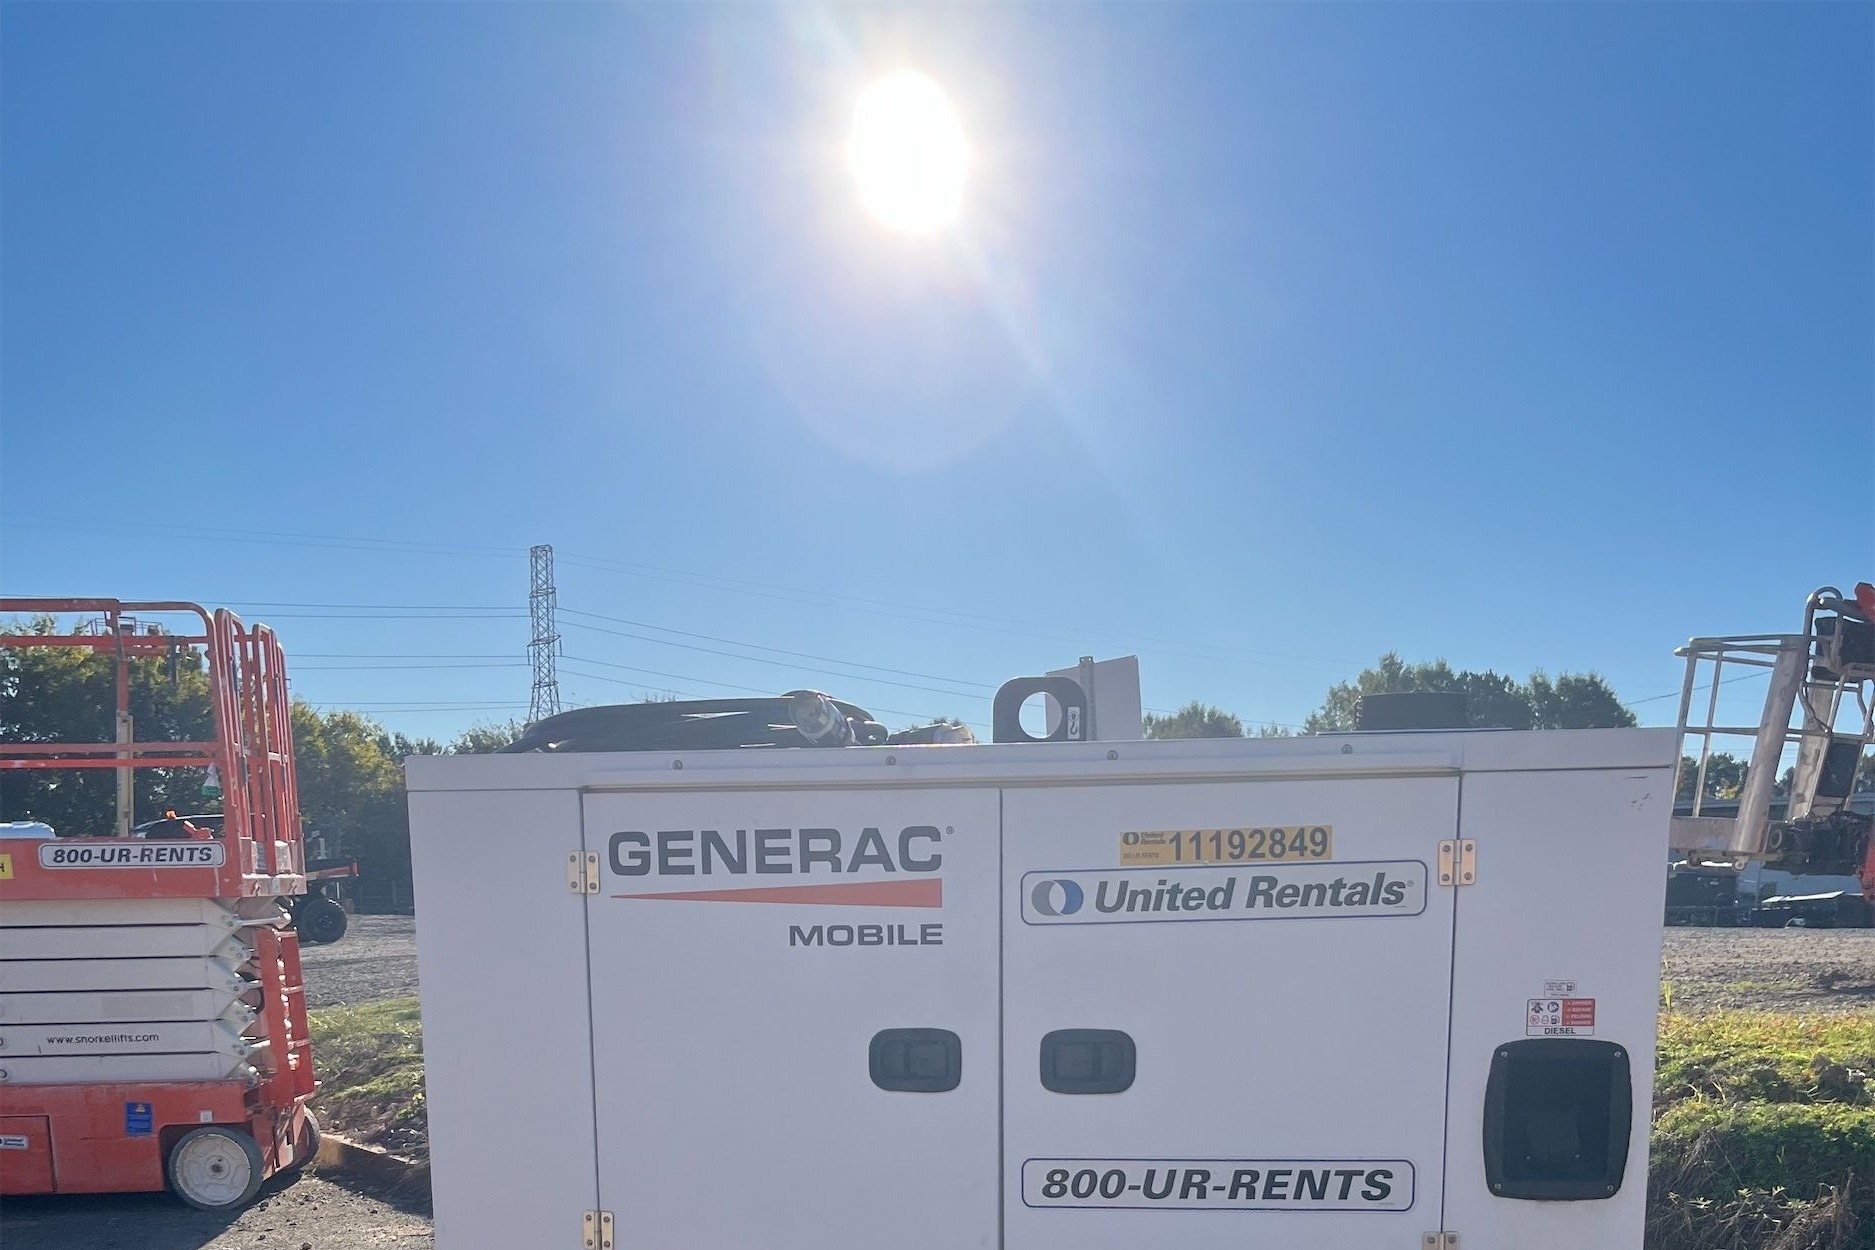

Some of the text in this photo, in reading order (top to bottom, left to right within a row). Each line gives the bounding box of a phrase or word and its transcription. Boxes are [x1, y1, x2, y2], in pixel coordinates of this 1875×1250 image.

[53, 846, 212, 864] 800-UR-RENTS
[608, 825, 942, 876] GENERAC
[1168, 827, 1328, 861] 11192849
[1095, 872, 1407, 913] United Rentals
[789, 924, 943, 947] MOBILE
[47, 1033, 160, 1044] www.snorkellifts.com
[1544, 1027, 1576, 1035] DIESEL
[1041, 1168, 1394, 1201] 800-UR-RENTS
